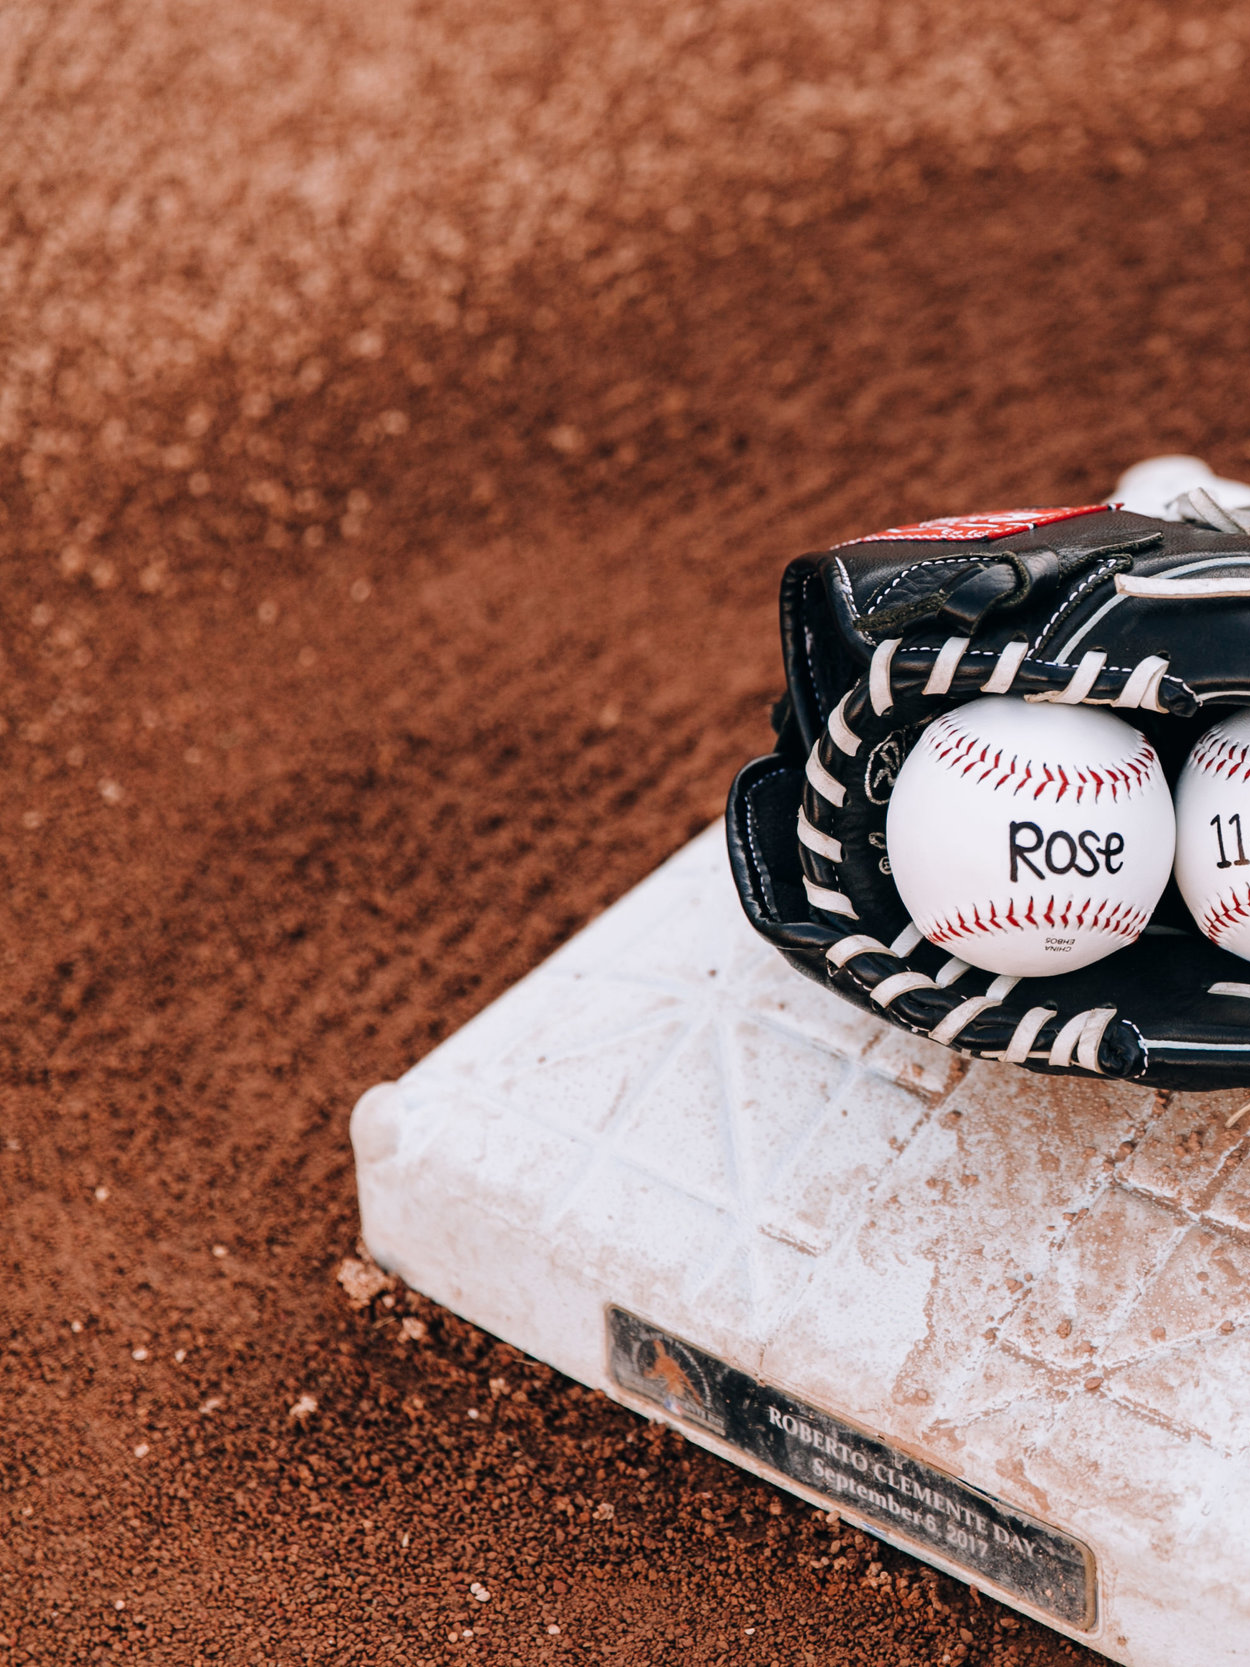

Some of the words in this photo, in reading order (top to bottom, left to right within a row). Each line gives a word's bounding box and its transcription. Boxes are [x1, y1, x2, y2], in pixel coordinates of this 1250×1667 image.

[1009, 820, 1125, 883] Rose
[1210, 813, 1250, 869] 11
[1044, 945, 1072, 953] CHINA
[767, 1405, 869, 1473] ROBERTO
[873, 1463, 989, 1536] CLEMENTE
[993, 1522, 1037, 1558] DAY
[811, 1457, 923, 1526] September
[947, 1524, 990, 1558] 2017
